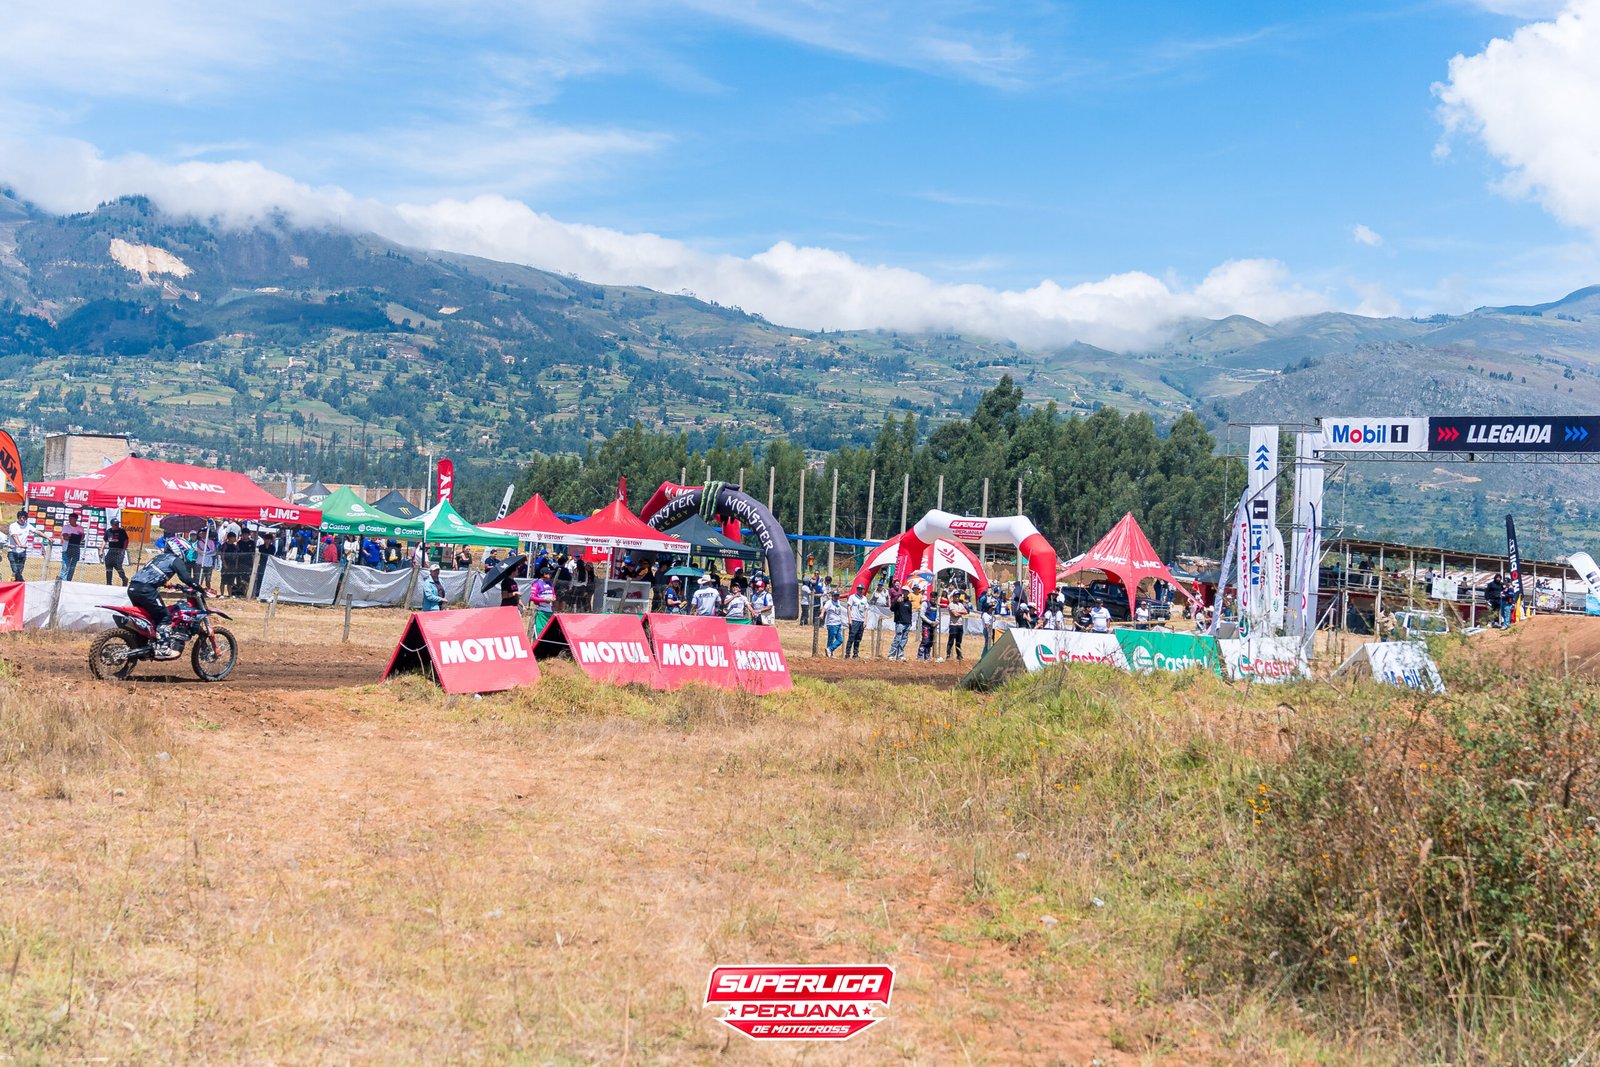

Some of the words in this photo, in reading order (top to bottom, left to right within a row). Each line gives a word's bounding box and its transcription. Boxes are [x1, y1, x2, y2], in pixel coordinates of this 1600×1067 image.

[1332, 424, 1386, 443] Mobil
[1392, 426, 1406, 443] 1
[1466, 424, 1552, 444] LLEGADA
[36, 486, 55, 497] JMC
[69, 489, 89, 501] JMC
[178, 481, 226, 494] JMC
[127, 497, 161, 509] JMC
[269, 508, 299, 520] JMC
[1101, 554, 1127, 565] JMC
[1140, 560, 1162, 569] JMC
[1509, 555, 1520, 593] Mobil
[439, 635, 528, 665] MOTUL
[579, 641, 650, 663] MOTUL
[662, 643, 729, 667] MOTUL
[736, 649, 785, 672] MOTUL
